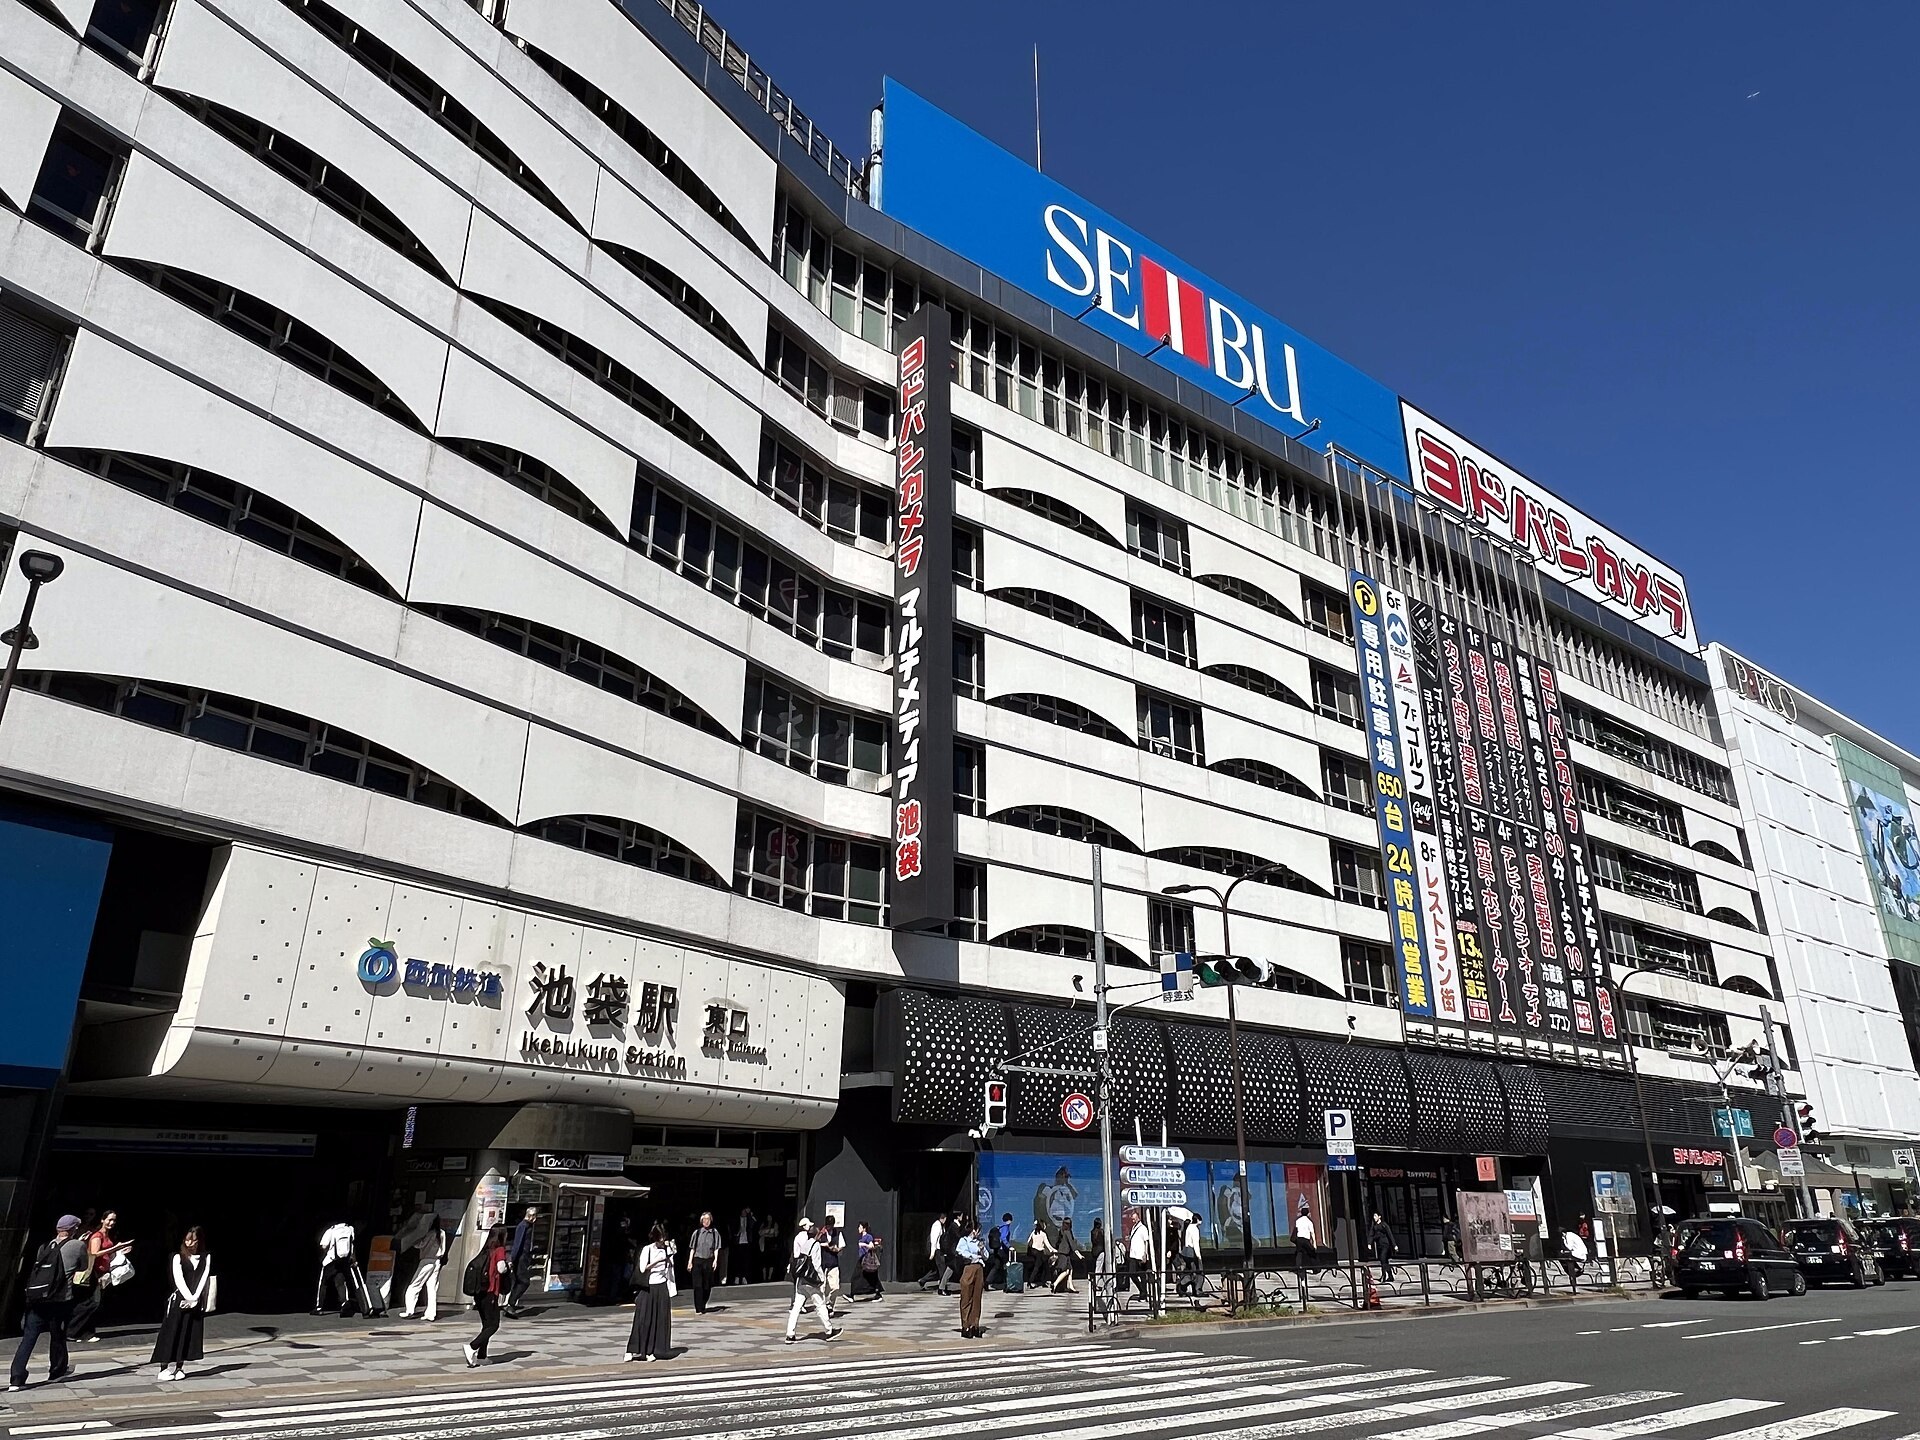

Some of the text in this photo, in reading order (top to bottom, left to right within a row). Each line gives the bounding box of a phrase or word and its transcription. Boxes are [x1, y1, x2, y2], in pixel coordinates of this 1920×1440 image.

[1044, 204, 1310, 426] SEIBU
[1416, 430, 1689, 640] ヨドバシカメラ
[896, 334, 926, 882] ヨドバシカメラ マルチメディア 池袋
[1386, 591, 1401, 611] 6F
[1440, 615, 1455, 635] 2F
[1466, 628, 1497, 741] 1F 携帯電話
[1493, 660, 1522, 751] 携帯電話
[1401, 700, 1425, 790] 7F ゴルフ
[1482, 741, 1500, 812] インターネット
[1492, 743, 1510, 814] スマートフォン
[1360, 620, 1395, 769] 専用駐車場
[1386, 843, 1428, 1008] 24時間営業
[1470, 811, 1485, 833] 5F
[1516, 752, 1533, 823] アクセサリー
[1498, 821, 1512, 841] 4F
[1538, 665, 1579, 834] ヨドバシカメラ
[1569, 843, 1604, 984] マルチメディア
[1596, 985, 1617, 1039] 池袋
[1421, 841, 1456, 1012] 8F レストラン街
[1473, 836, 1517, 1024] 玩具・ホビー・ゲーム
[1522, 828, 1557, 959] 3F 家電製品
[404, 957, 503, 995] 西武鉄道
[528, 961, 678, 1037] 池袋駅
[1162, 989, 1194, 1003] 時差式
[523, 1031, 687, 1071] Ikebukuro Station
[704, 1004, 748, 1036] 東口
[1329, 1113, 1347, 1136] P
